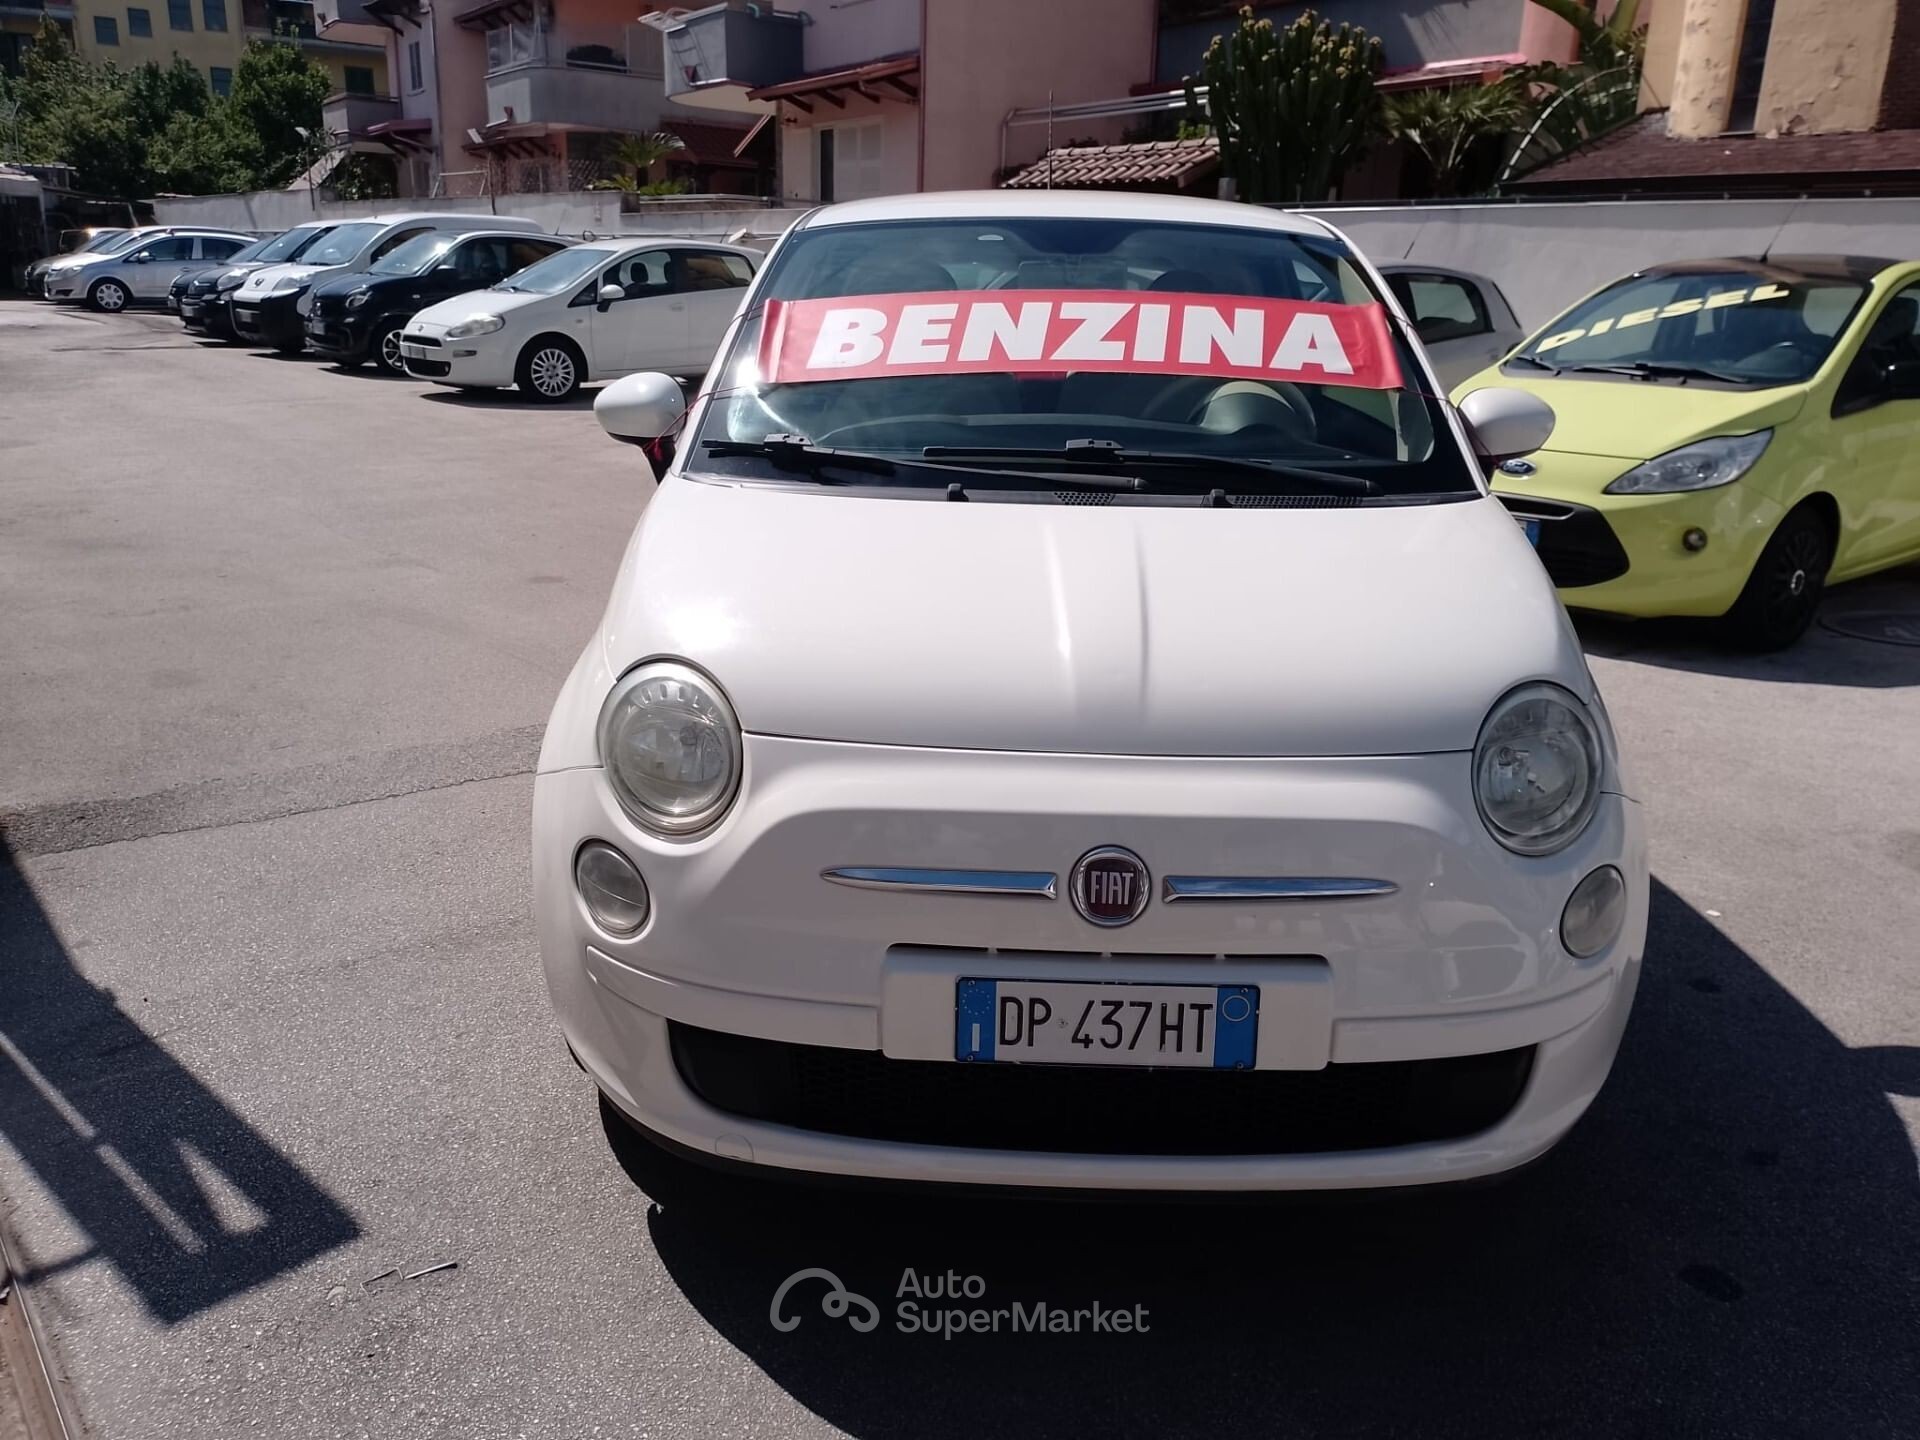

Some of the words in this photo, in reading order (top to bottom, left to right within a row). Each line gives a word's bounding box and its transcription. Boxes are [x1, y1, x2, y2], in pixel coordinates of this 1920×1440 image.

[807, 302, 1354, 375] BENZINA
[1535, 284, 1790, 353] DIESEL
[1090, 871, 1134, 905] FIAT
[1000, 996, 1051, 1047] DP
